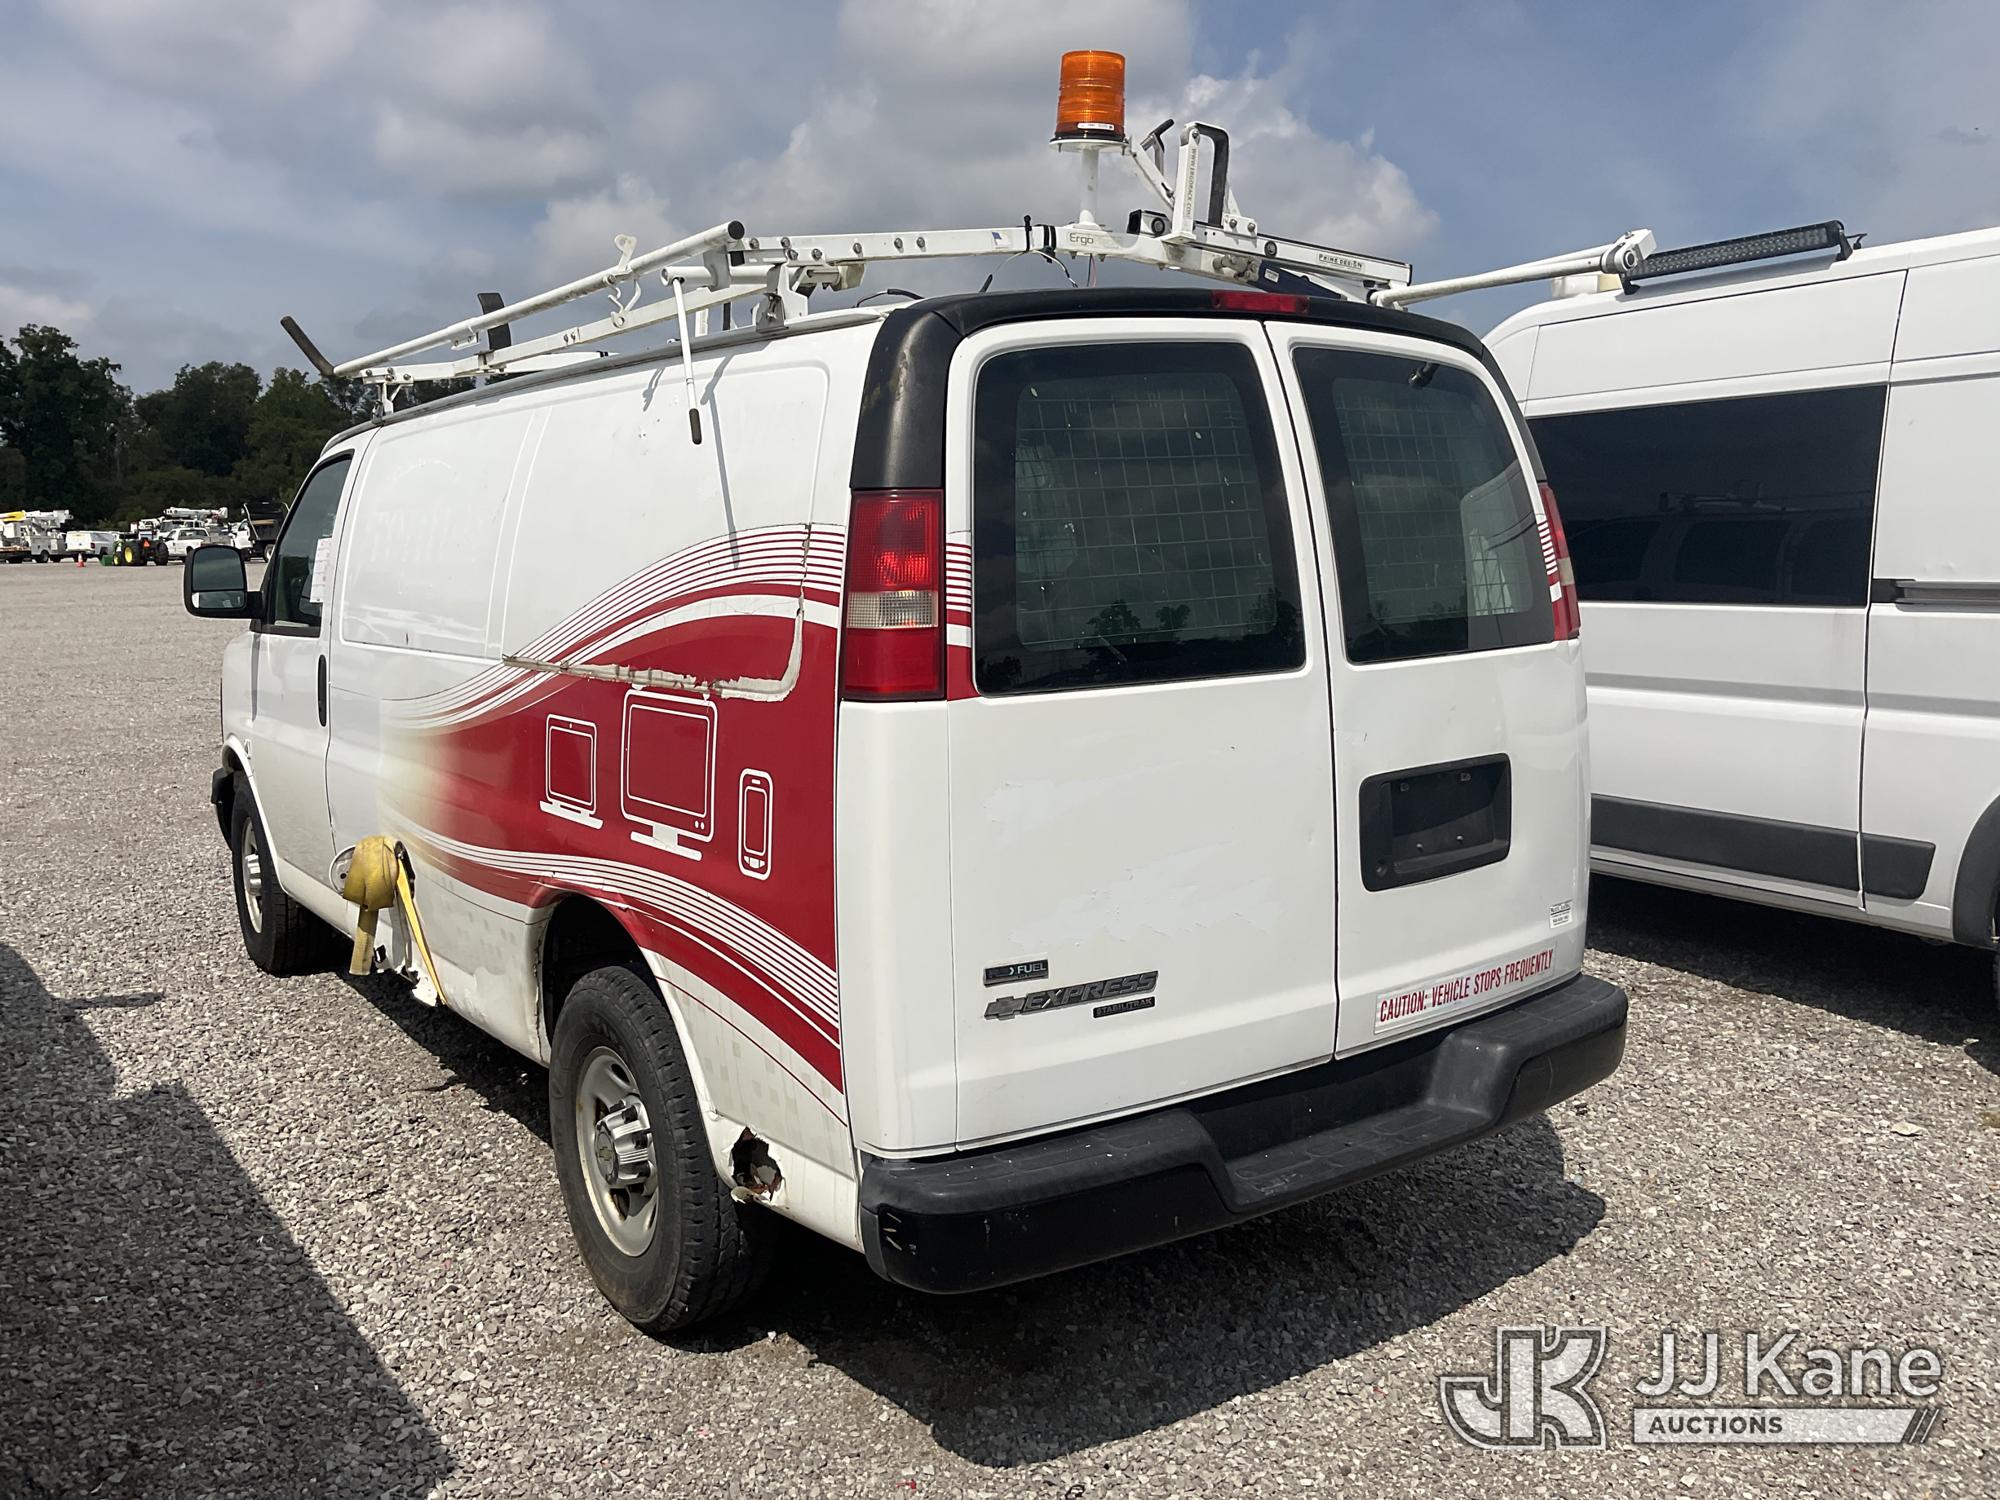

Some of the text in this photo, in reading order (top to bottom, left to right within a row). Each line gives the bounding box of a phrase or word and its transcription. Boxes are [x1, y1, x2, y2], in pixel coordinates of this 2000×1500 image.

[1069, 232, 1094, 245] Ergo
[1017, 962, 1047, 975] FUEL
[1022, 972, 1158, 1012] EXPRESS
[1379, 948, 1554, 1022] CAUTION: VEHICLE STOPS FREQUENTLY
